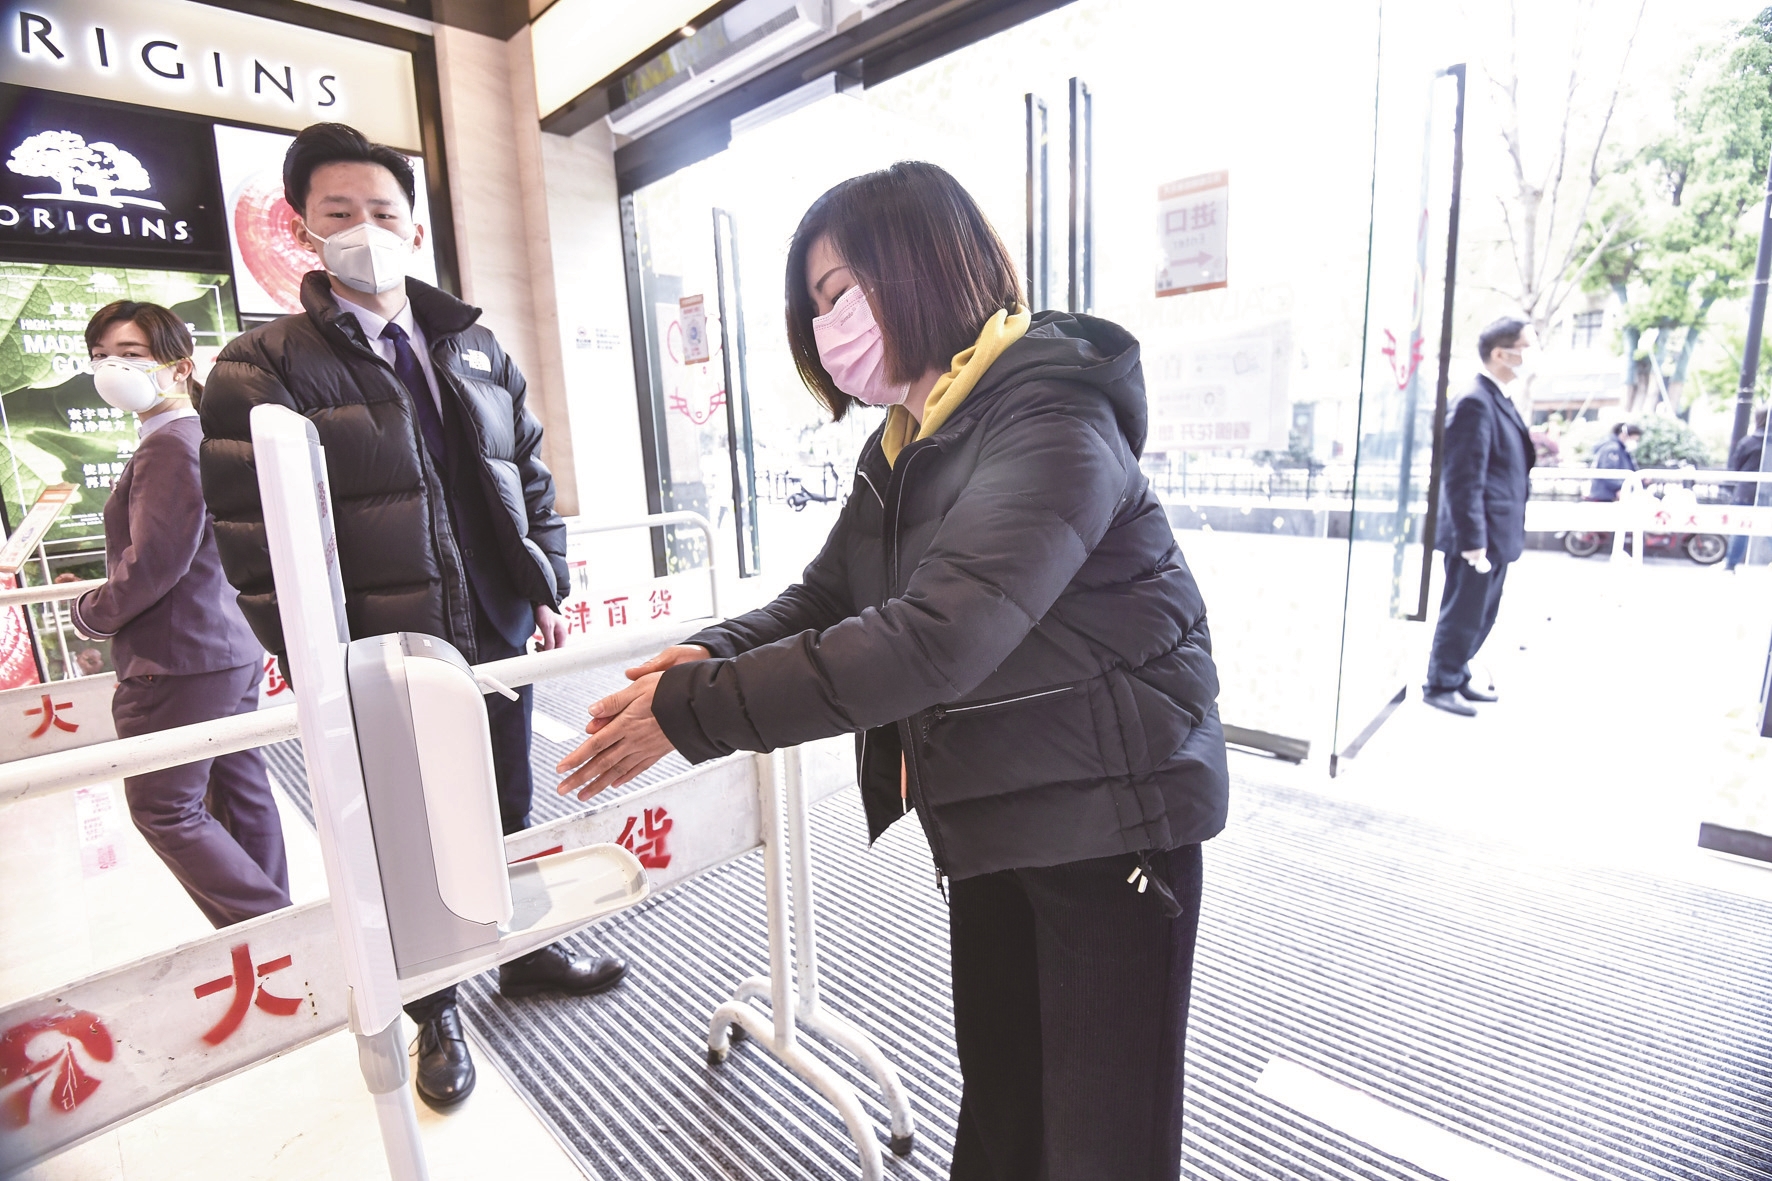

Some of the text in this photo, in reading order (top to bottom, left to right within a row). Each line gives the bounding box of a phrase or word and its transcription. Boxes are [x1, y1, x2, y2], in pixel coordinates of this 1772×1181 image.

[19, 11, 336, 107] RIGINS
[0, 204, 189, 241] ORIGINS
[24, 334, 88, 353] MADE
[24, 694, 79, 739] 大
[194, 943, 304, 1047] 大
